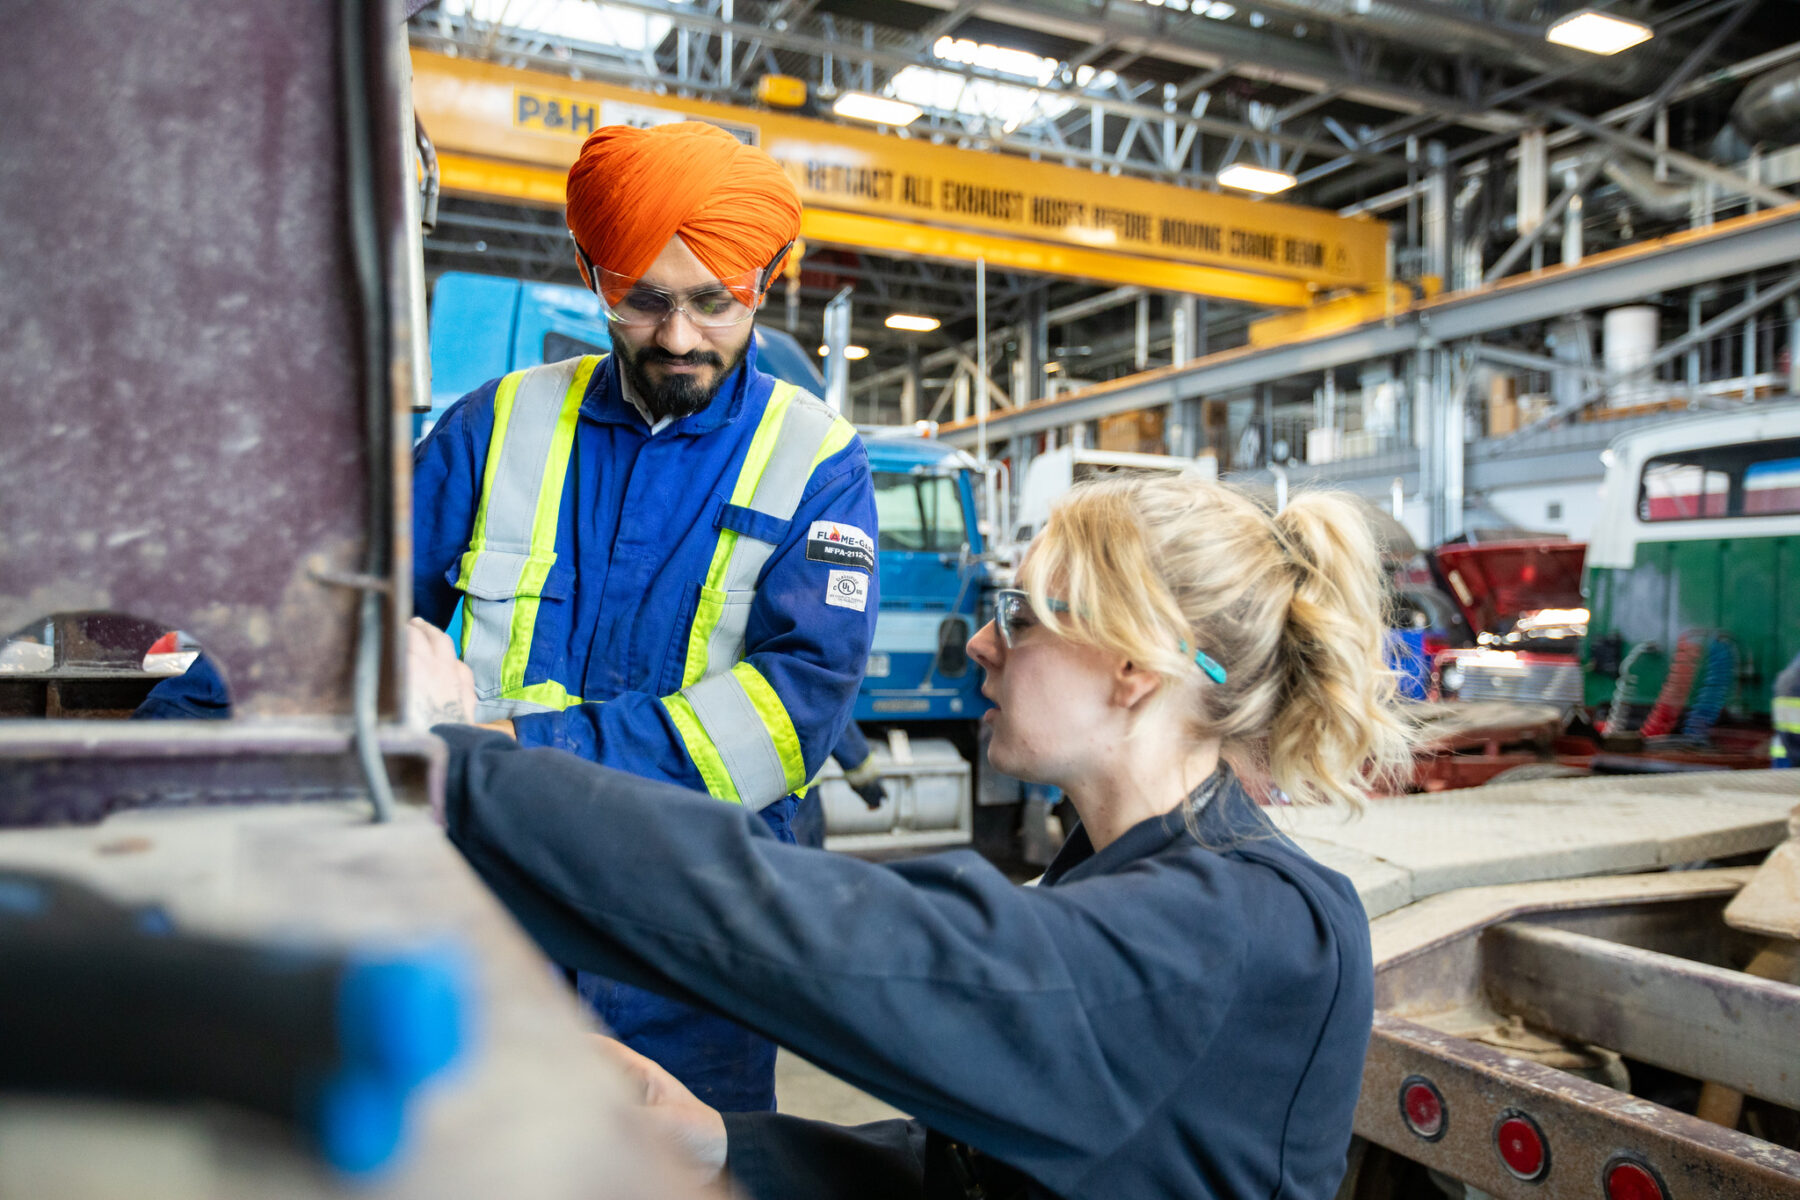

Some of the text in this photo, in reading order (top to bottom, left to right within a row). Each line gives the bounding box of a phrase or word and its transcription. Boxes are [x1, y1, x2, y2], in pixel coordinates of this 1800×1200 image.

[518, 95, 595, 132] P&H
[807, 160, 893, 200] RETRACT
[903, 174, 934, 208] ALL
[941, 180, 1024, 222] EXHAUST
[1033, 195, 1085, 231] HOSES
[1160, 217, 1222, 252] MOVING
[1230, 229, 1278, 261] CRANE
[1285, 237, 1326, 267] BEAM
[842, 582, 851, 593] UL
